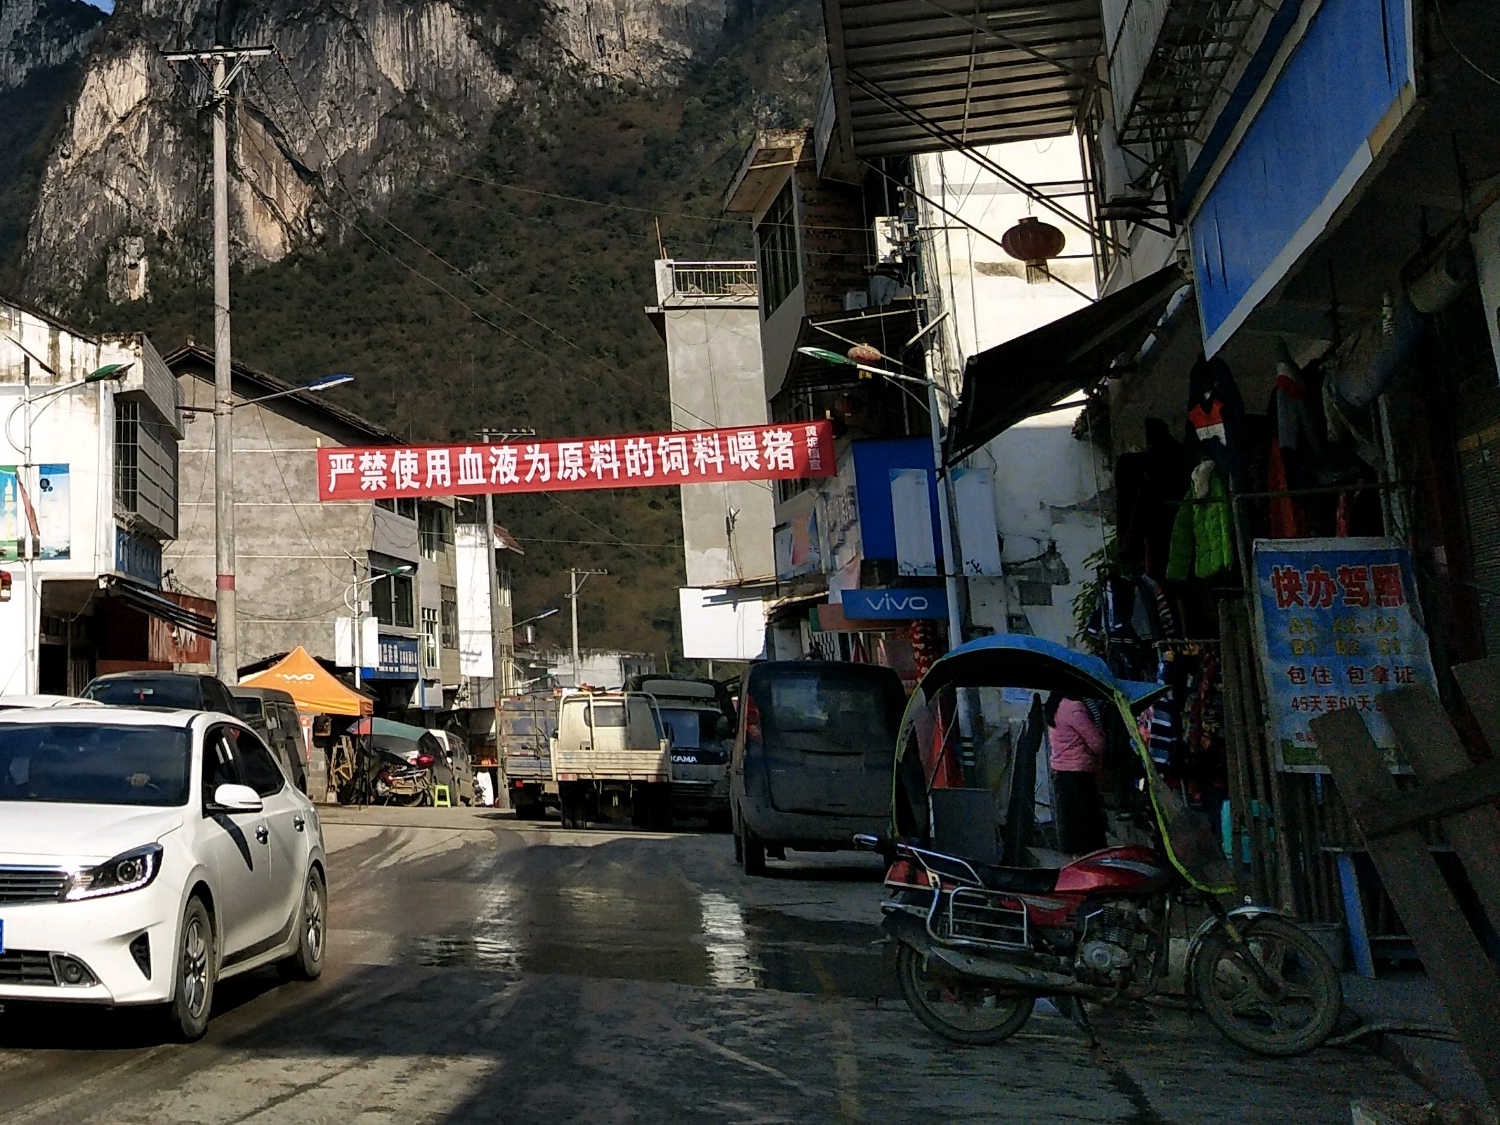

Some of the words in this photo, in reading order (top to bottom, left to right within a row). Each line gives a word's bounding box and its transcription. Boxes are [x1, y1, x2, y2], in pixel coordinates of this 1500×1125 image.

[327, 427, 795, 493] 严禁使用血液为原料的饲料喂猪
[866, 592, 929, 611] vivo
